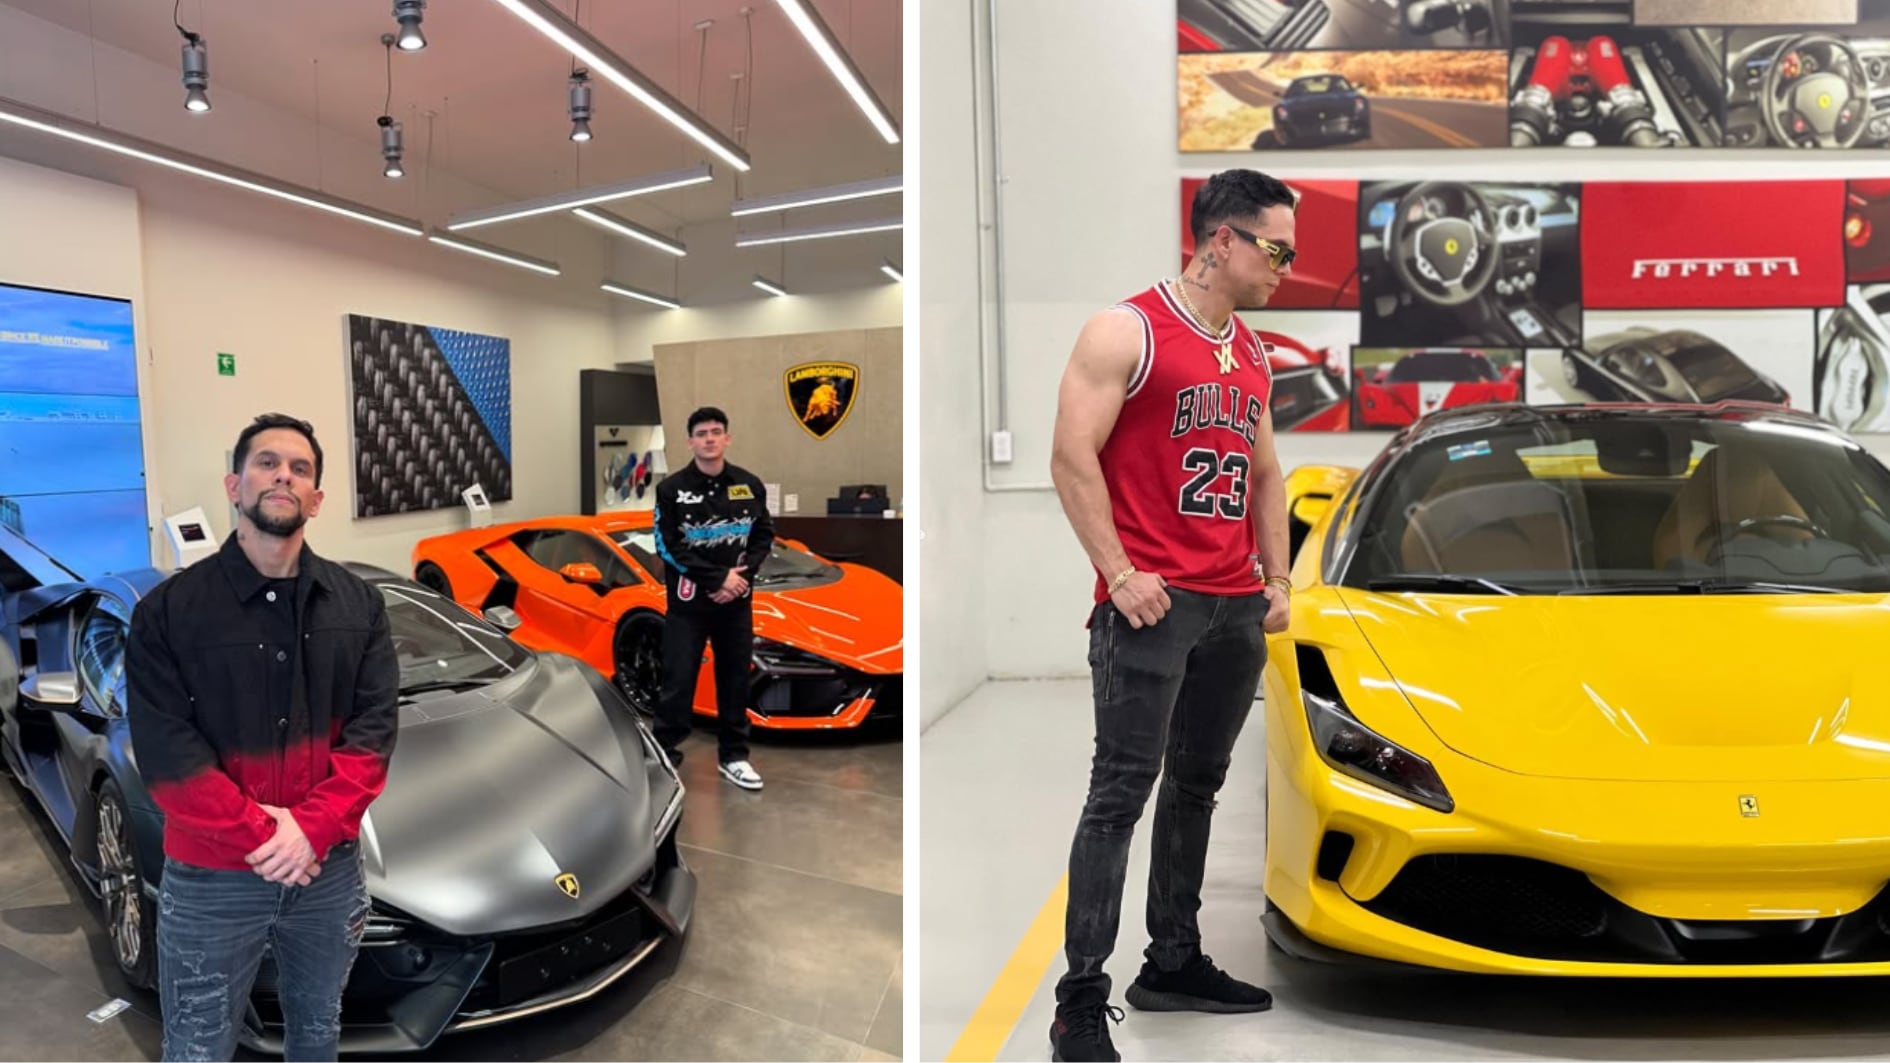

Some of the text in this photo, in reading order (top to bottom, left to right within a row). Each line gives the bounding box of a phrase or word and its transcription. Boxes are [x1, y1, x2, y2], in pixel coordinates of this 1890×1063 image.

[1631, 257, 1800, 279] Ferrari
[1171, 382, 1263, 449] BULLS
[1178, 447, 1250, 520] 23
